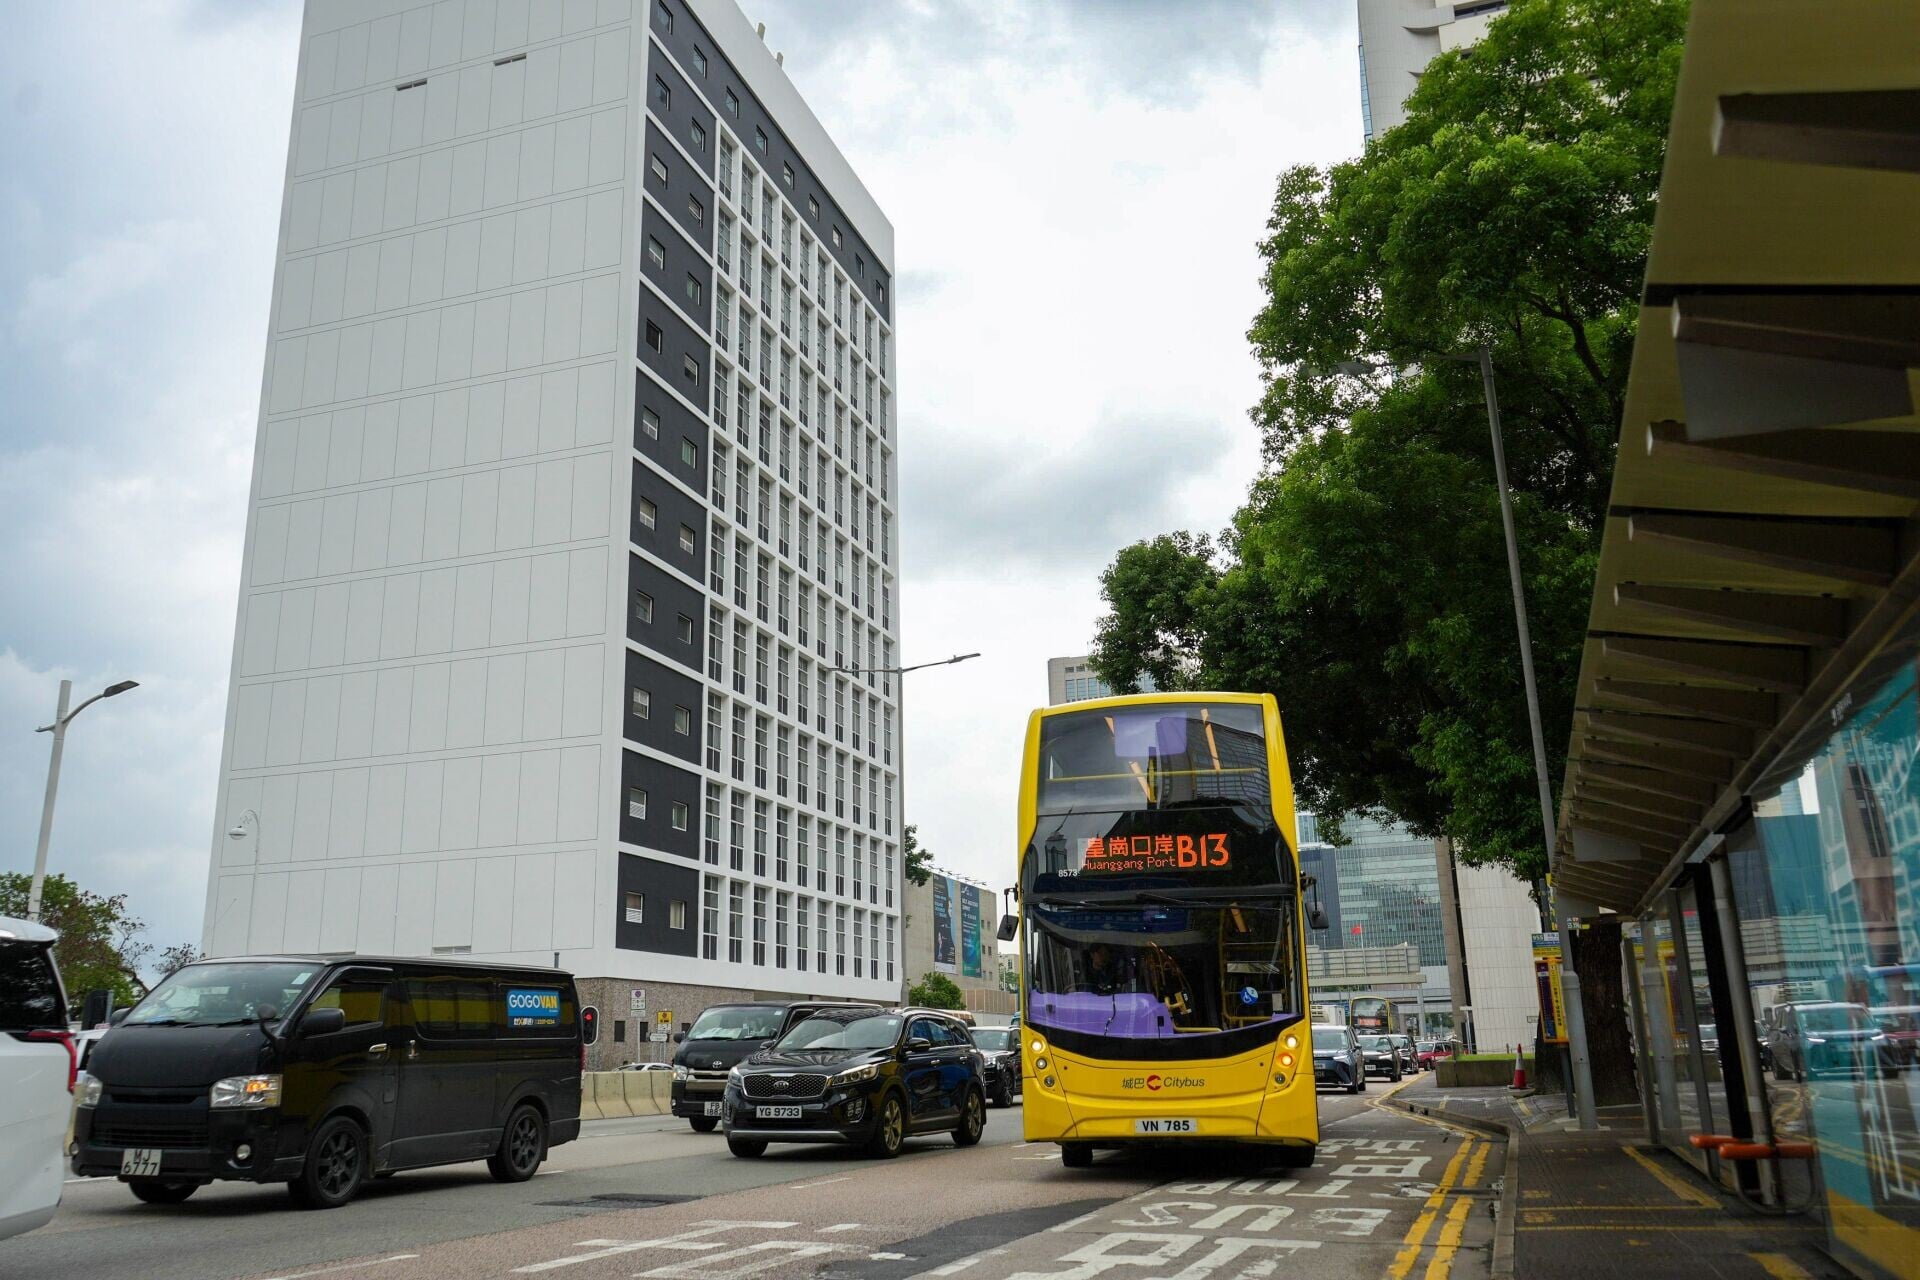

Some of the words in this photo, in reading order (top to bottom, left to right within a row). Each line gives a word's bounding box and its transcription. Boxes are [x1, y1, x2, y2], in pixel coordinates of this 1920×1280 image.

[1086, 834, 1174, 858] 皇崗口岸
[1177, 833, 1230, 868] B13
[1081, 858, 1144, 871] Huanggang
[1147, 856, 1176, 868] Port
[1058, 868, 1078, 878] 8573
[509, 994, 558, 1009] GOGOVAN
[1122, 1077, 1145, 1089] 城巴
[1163, 1077, 1205, 1089] Citybus
[759, 1108, 771, 1117] YG
[774, 1107, 800, 1117] 9733
[1142, 1120, 1159, 1132] VN
[1164, 1120, 1190, 1131] 785
[134, 1149, 152, 1162] MJ
[123, 1161, 158, 1175] 6777
[1112, 1201, 1392, 1236] BUS
